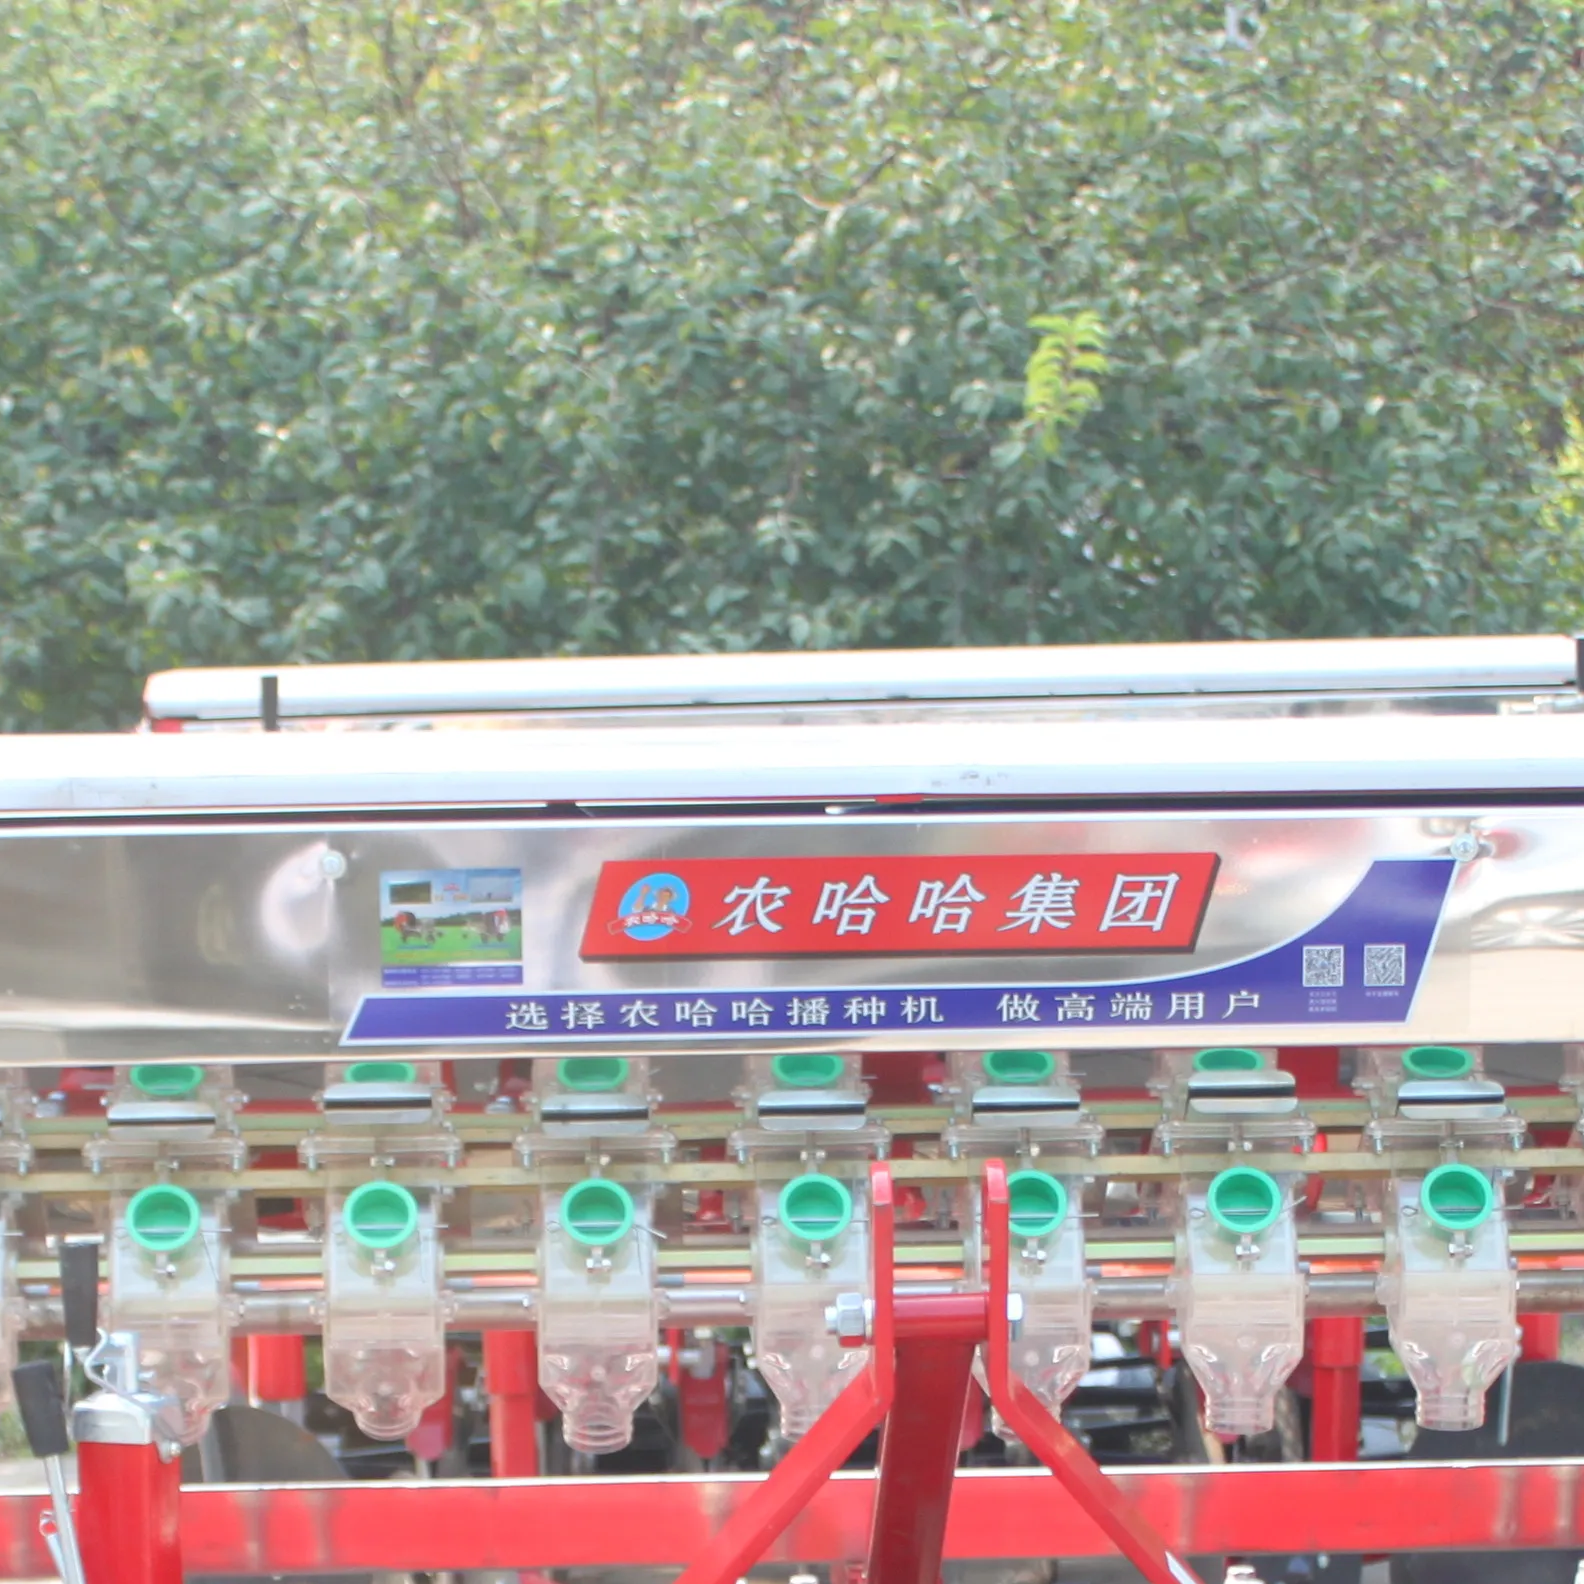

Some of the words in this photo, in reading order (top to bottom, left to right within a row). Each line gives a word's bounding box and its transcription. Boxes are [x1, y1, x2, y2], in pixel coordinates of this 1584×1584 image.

[711, 871, 1181, 936] 农哈哈集团
[505, 994, 945, 1031] 选择农哈哈播种机
[995, 990, 1260, 1022] 做高端用户
